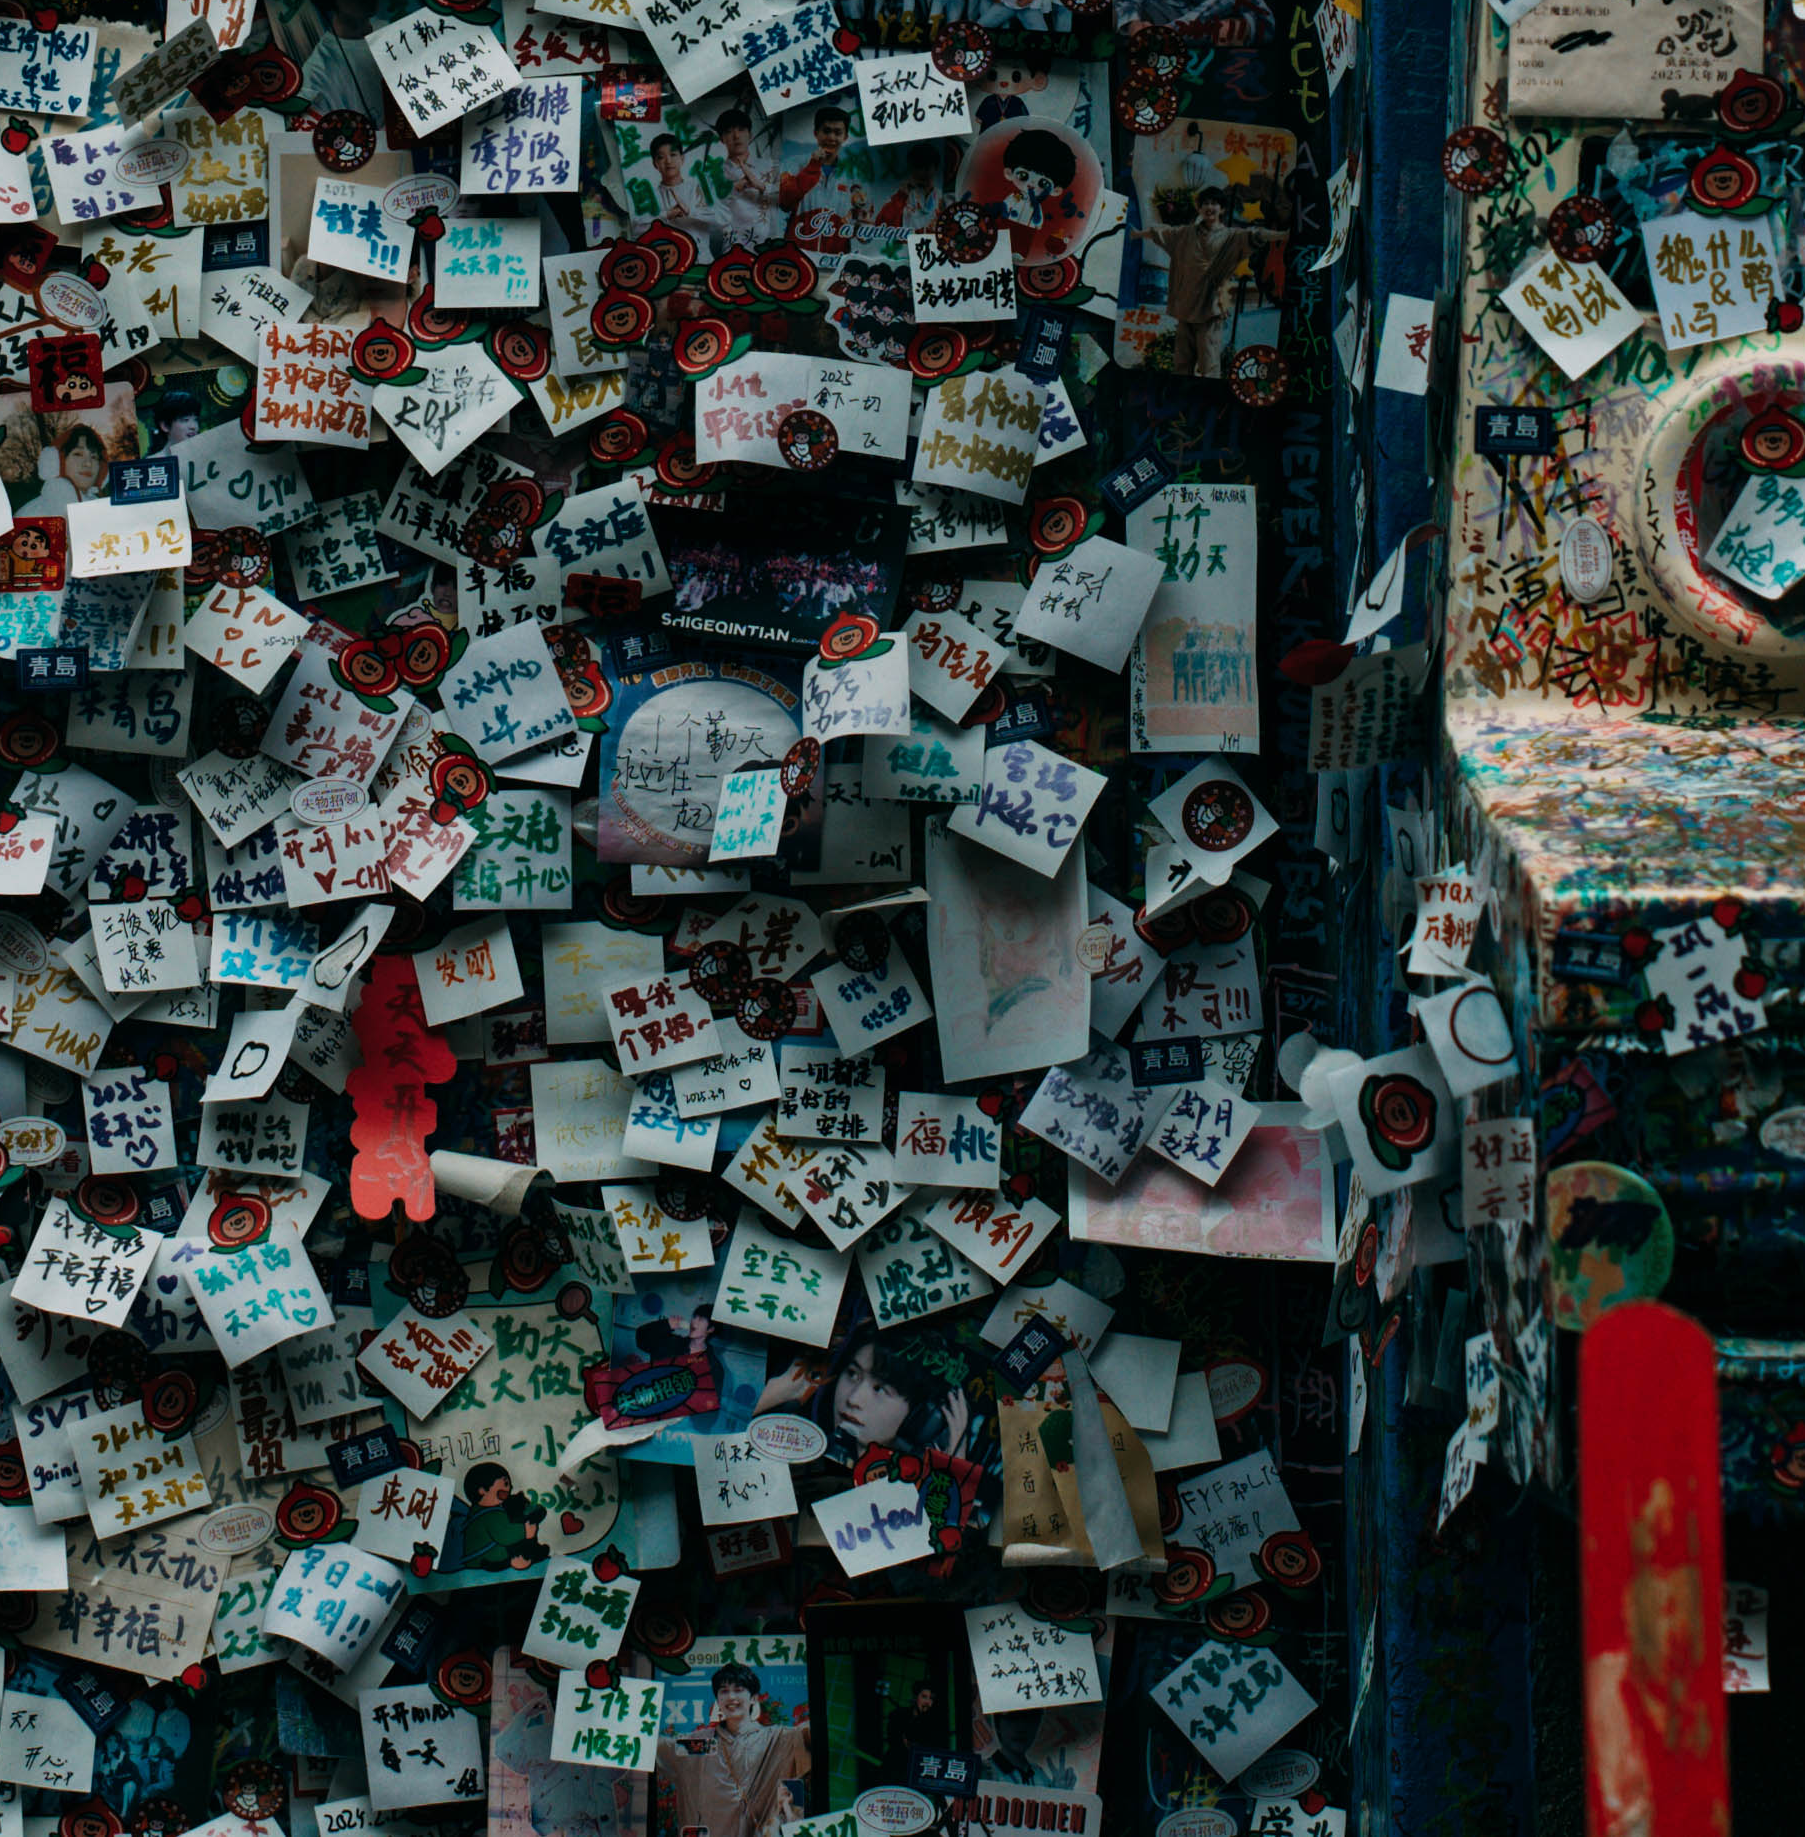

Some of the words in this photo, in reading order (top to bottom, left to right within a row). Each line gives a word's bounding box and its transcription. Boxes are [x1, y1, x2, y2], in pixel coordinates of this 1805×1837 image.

[209, 235, 256, 257] 青島
[1488, 411, 1539, 437] 青島
[121, 466, 169, 488] 青島
[662, 612, 791, 643] SHIGEQINTIAN
[28, 655, 76, 680] 青島
[919, 1756, 967, 1781] 青島
